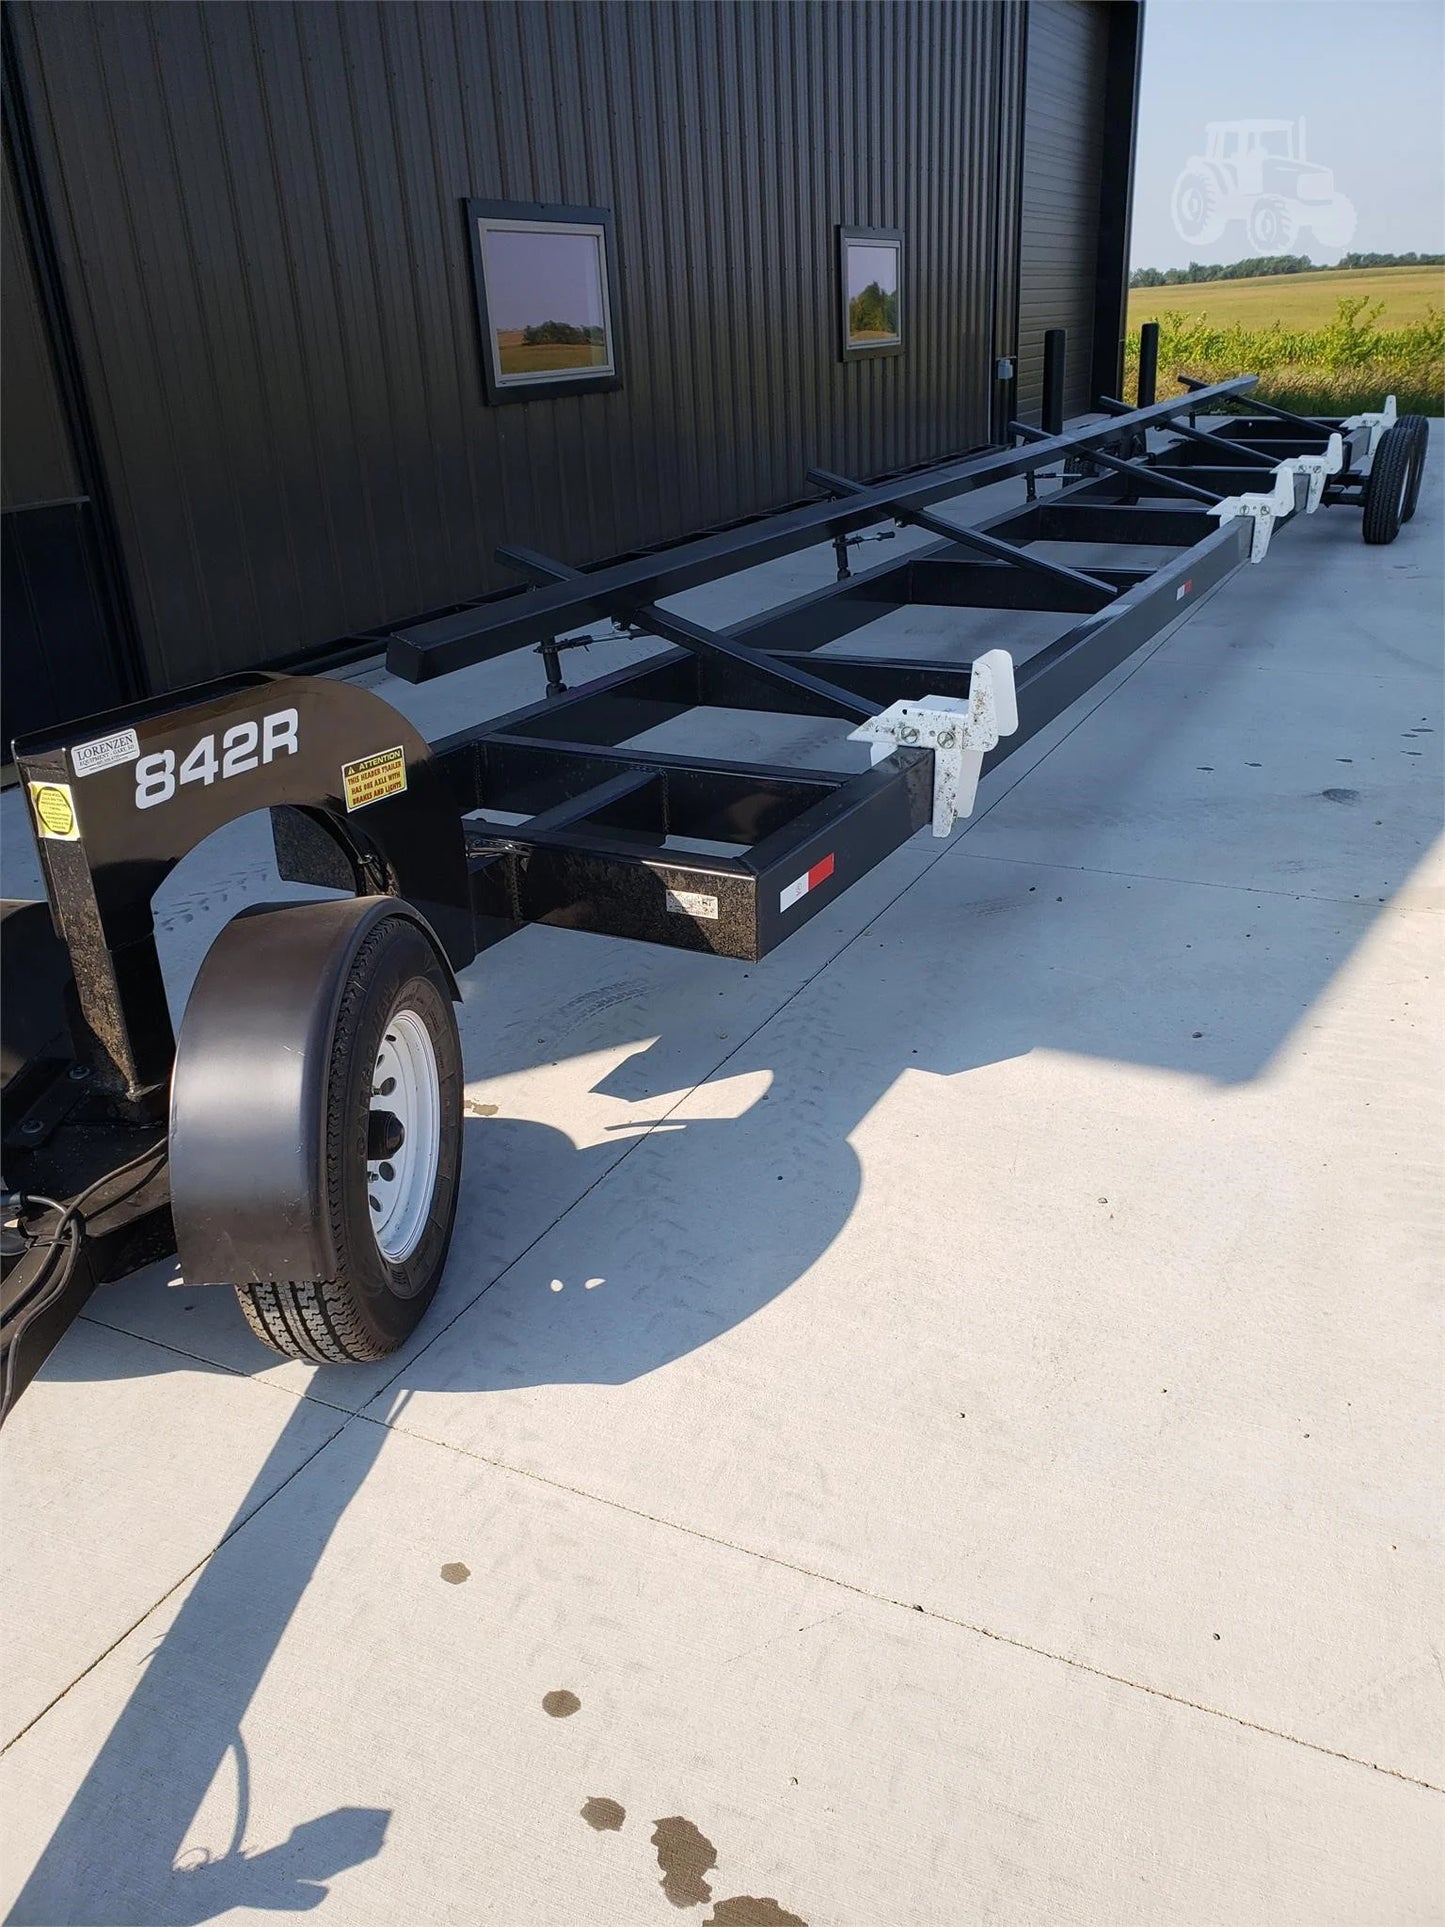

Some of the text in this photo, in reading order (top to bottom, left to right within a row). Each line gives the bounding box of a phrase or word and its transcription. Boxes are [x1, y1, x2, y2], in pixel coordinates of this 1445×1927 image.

[77, 734, 133, 761] LORENZEN
[79, 752, 109, 766] EQUIPMENT
[135, 708, 299, 811] 842R
[348, 761, 402, 785] THIS HEADER TRAILER
[359, 751, 401, 771] ATTENTION
[351, 772, 400, 795] HAS ONE AXLE WITH
[352, 781, 402, 805] BRAKES AND LIGHTS
